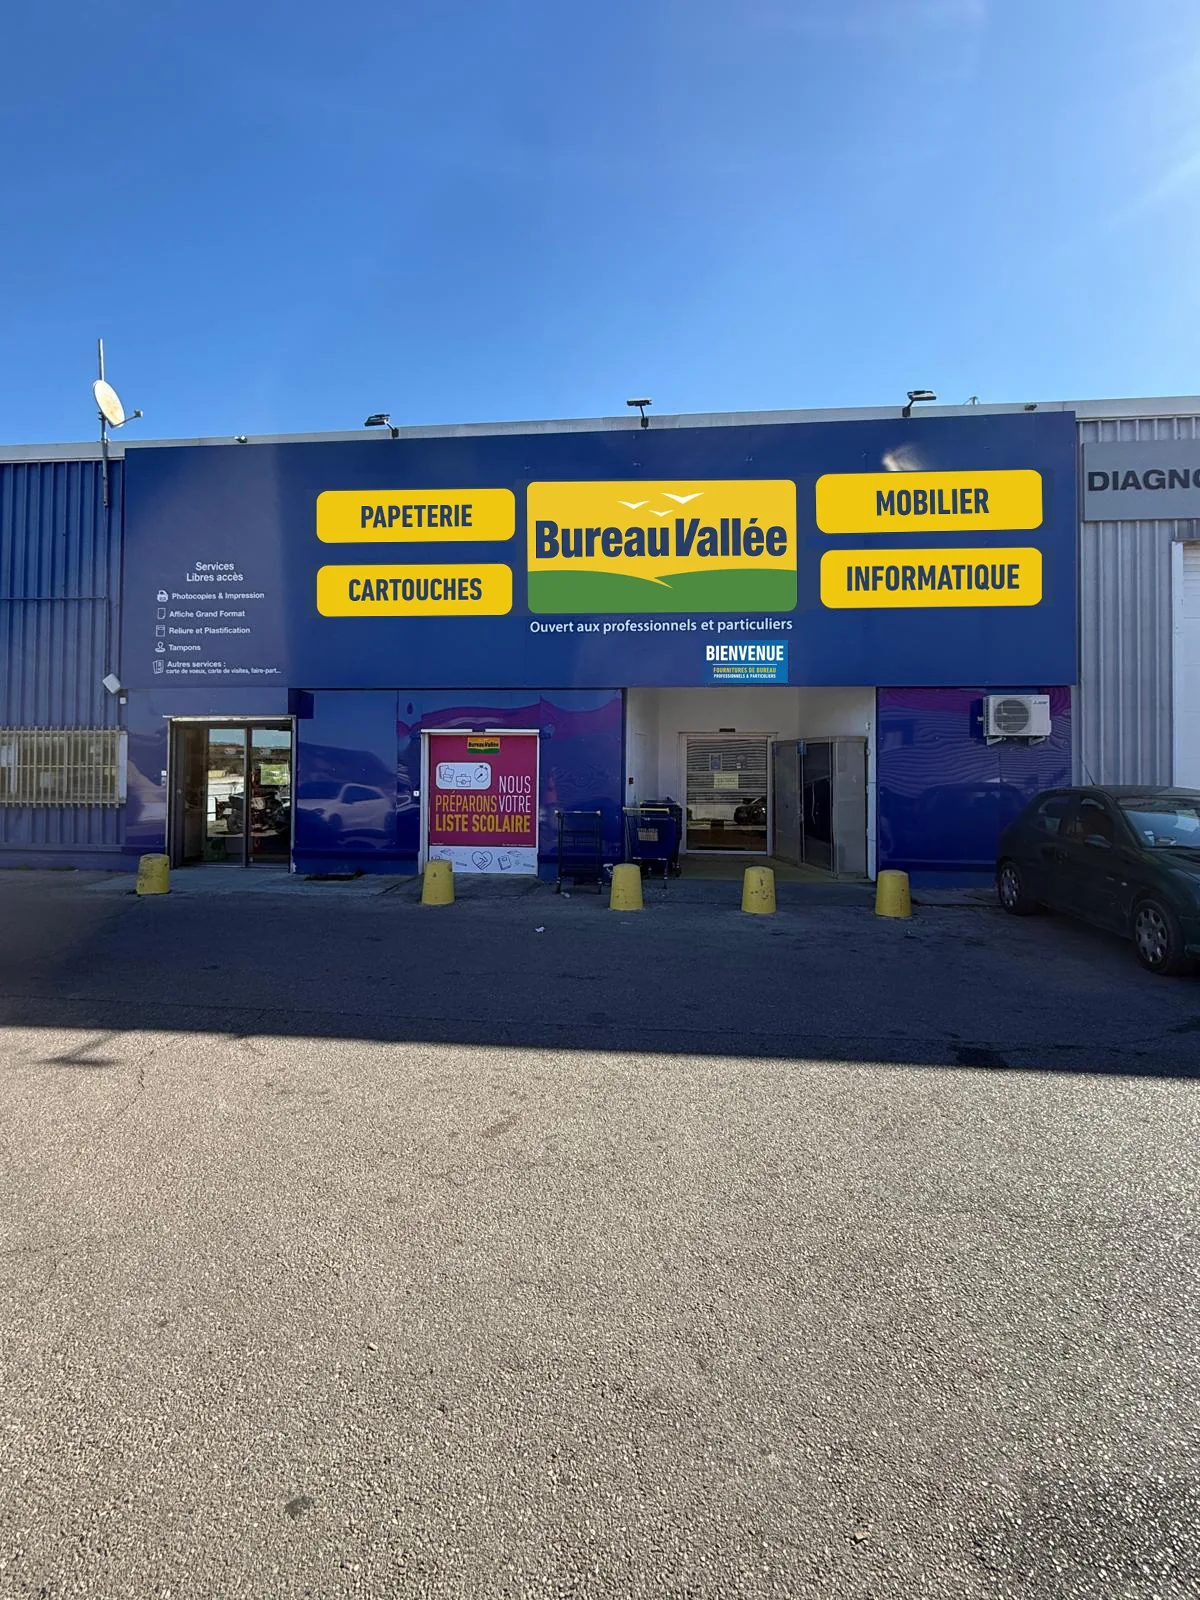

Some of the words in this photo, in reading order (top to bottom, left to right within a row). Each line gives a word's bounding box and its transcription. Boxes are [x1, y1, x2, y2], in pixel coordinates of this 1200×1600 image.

[876, 488, 990, 516] MOBILIER
[360, 504, 473, 528] PAPETERIE
[535, 520, 670, 559] Bureau
[675, 517, 788, 557] Vallée
[195, 561, 235, 571] Services
[186, 572, 215, 582] Libres
[216, 572, 244, 582] accès
[846, 564, 1020, 592] INFORMATIQUE
[171, 592, 217, 601] Photocopies
[218, 592, 224, 600] &
[225, 591, 265, 600] Impression
[348, 577, 483, 602] CARTOUCHES
[169, 610, 195, 618] Affiche
[195, 610, 218, 618] Grand
[219, 610, 246, 618] Format
[168, 627, 194, 635] Reliure
[195, 627, 203, 635] et
[204, 626, 251, 635] Plastification
[530, 621, 574, 633] Ouvert
[576, 622, 600, 632] aux
[603, 619, 697, 635] professionnels
[700, 620, 714, 631] et
[717, 618, 793, 633] particuliers
[168, 643, 202, 653] Tampons
[706, 645, 784, 661] BIENVENUE
[167, 660, 190, 668] Autres
[499, 775, 531, 794] NOUS
[435, 791, 497, 813] PRÉPARONS
[498, 795, 531, 813] VOTRE
[435, 814, 469, 832] LISTE
[472, 814, 531, 833] SCOLAIRE
